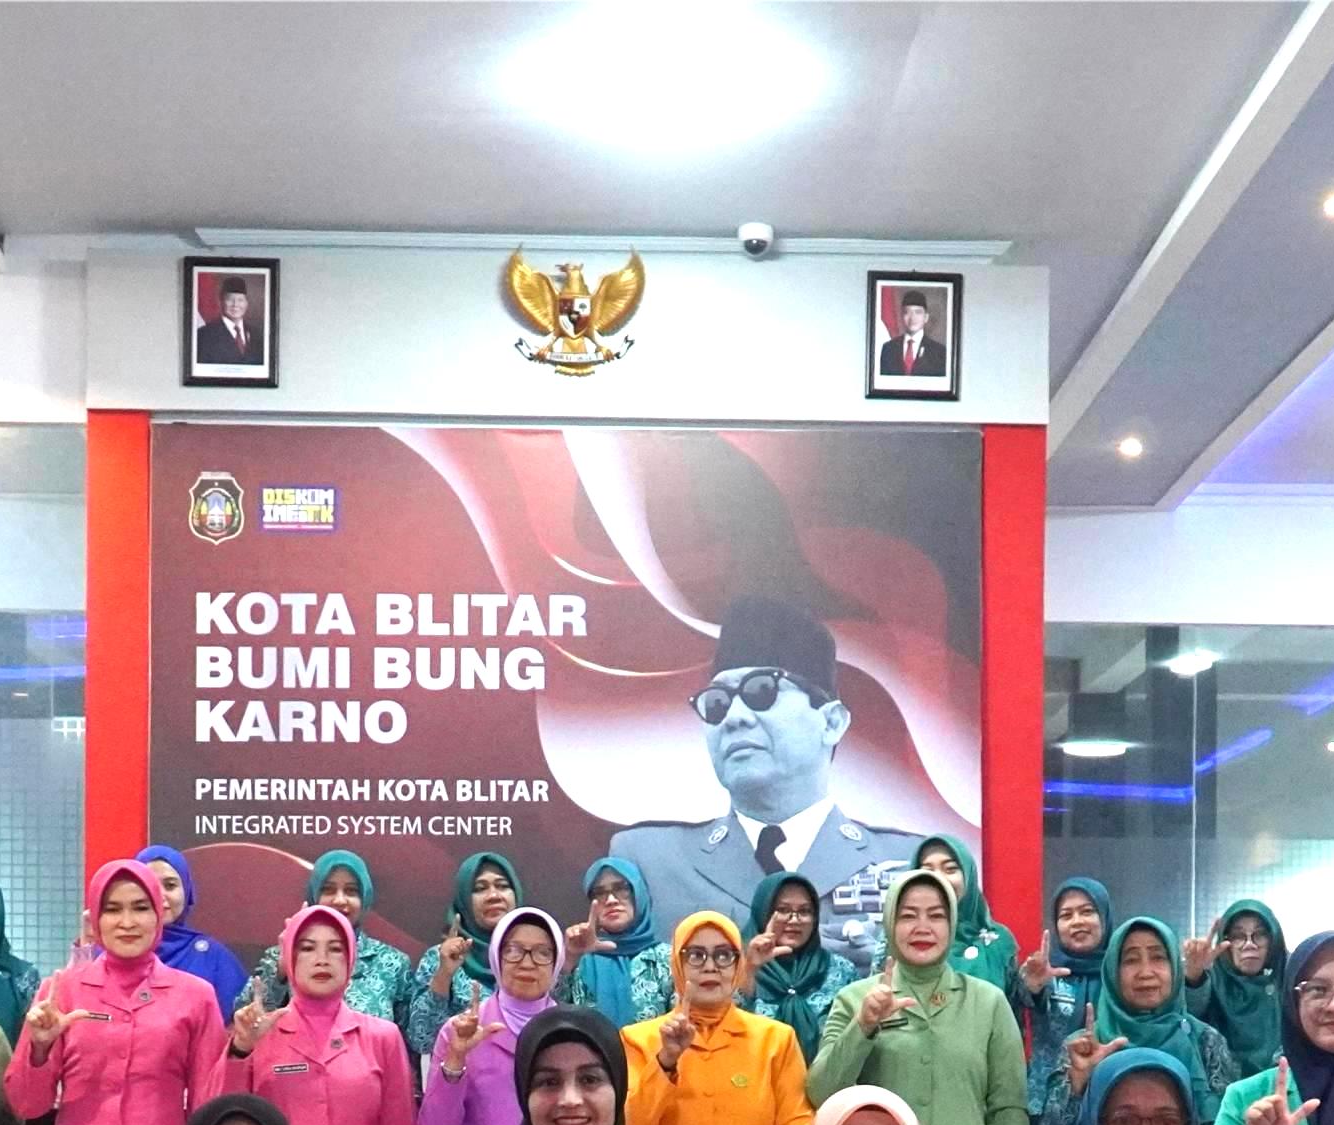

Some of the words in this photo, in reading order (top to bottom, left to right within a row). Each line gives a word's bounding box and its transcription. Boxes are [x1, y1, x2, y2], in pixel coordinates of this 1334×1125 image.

[195, 591, 355, 635] KOTA
[375, 592, 587, 636] BLITAR
[195, 645, 350, 689] BUMI
[373, 646, 545, 691] BUNG
[195, 699, 407, 744] KARNO
[195, 778, 370, 800] PEMERINTAH
[378, 778, 448, 801] KOTA
[456, 779, 548, 801] BLITAR
[195, 815, 331, 834] INTEGRATED
[337, 815, 421, 834] SYSTEM
[427, 815, 511, 835] CENTER
